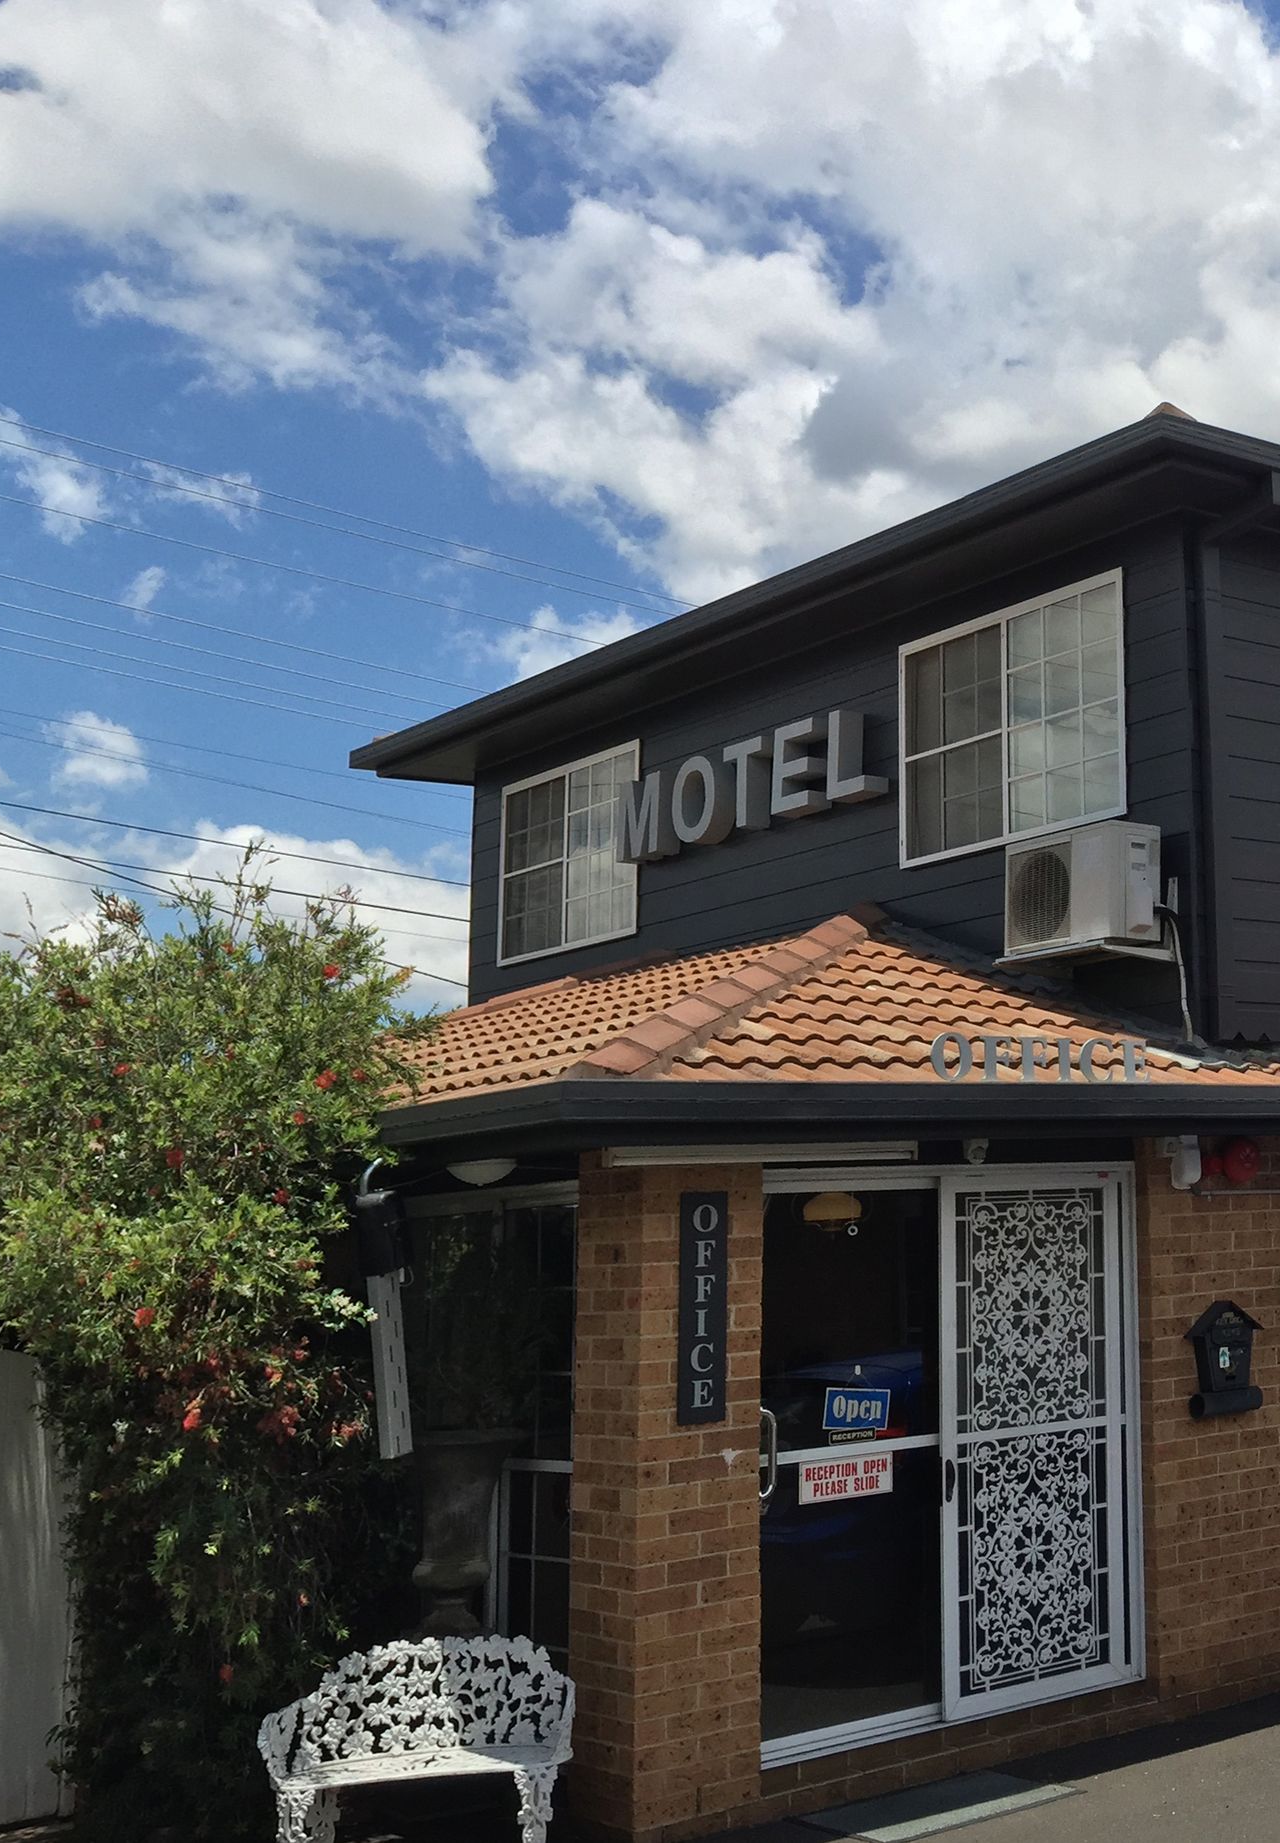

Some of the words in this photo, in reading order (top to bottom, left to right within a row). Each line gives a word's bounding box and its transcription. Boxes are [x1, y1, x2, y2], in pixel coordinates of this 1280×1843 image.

[616, 709, 889, 865] MOTEL
[930, 1031, 1151, 1083] OFFICE
[690, 1204, 719, 1408] OFFICE
[832, 1395, 882, 1423] Open
[832, 1430, 873, 1441] RECEPTION
[805, 1462, 858, 1482] RECEPTION
[863, 1458, 888, 1474] OPEN
[813, 1479, 848, 1497] PLEASE
[854, 1475, 879, 1492] SLIDE
